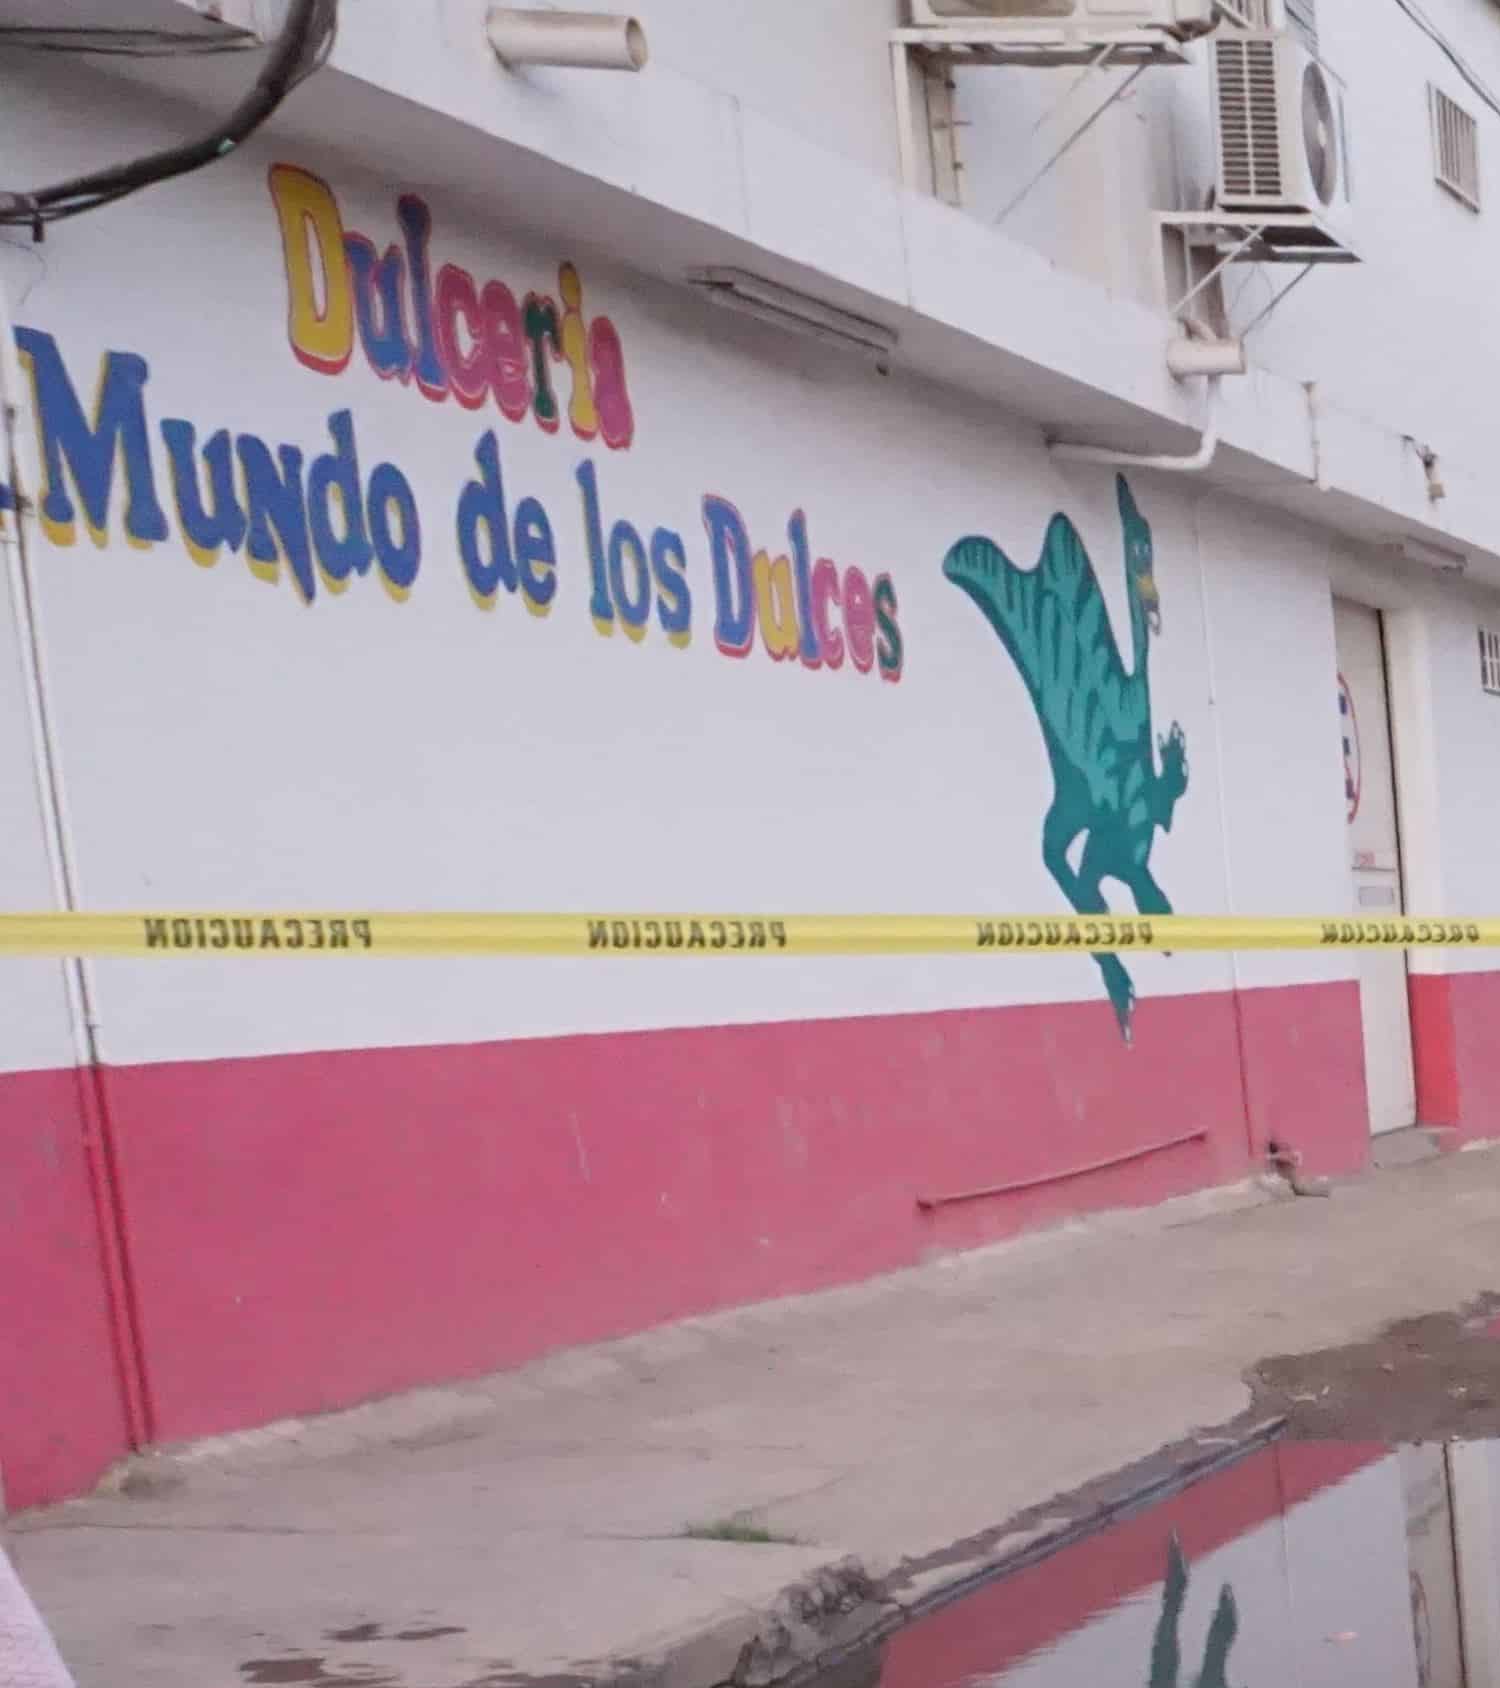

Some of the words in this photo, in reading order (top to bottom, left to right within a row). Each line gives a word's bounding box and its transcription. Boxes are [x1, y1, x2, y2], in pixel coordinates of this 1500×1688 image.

[457, 428, 557, 618] de
[577, 459, 693, 649] los
[703, 493, 904, 684] Dulces
